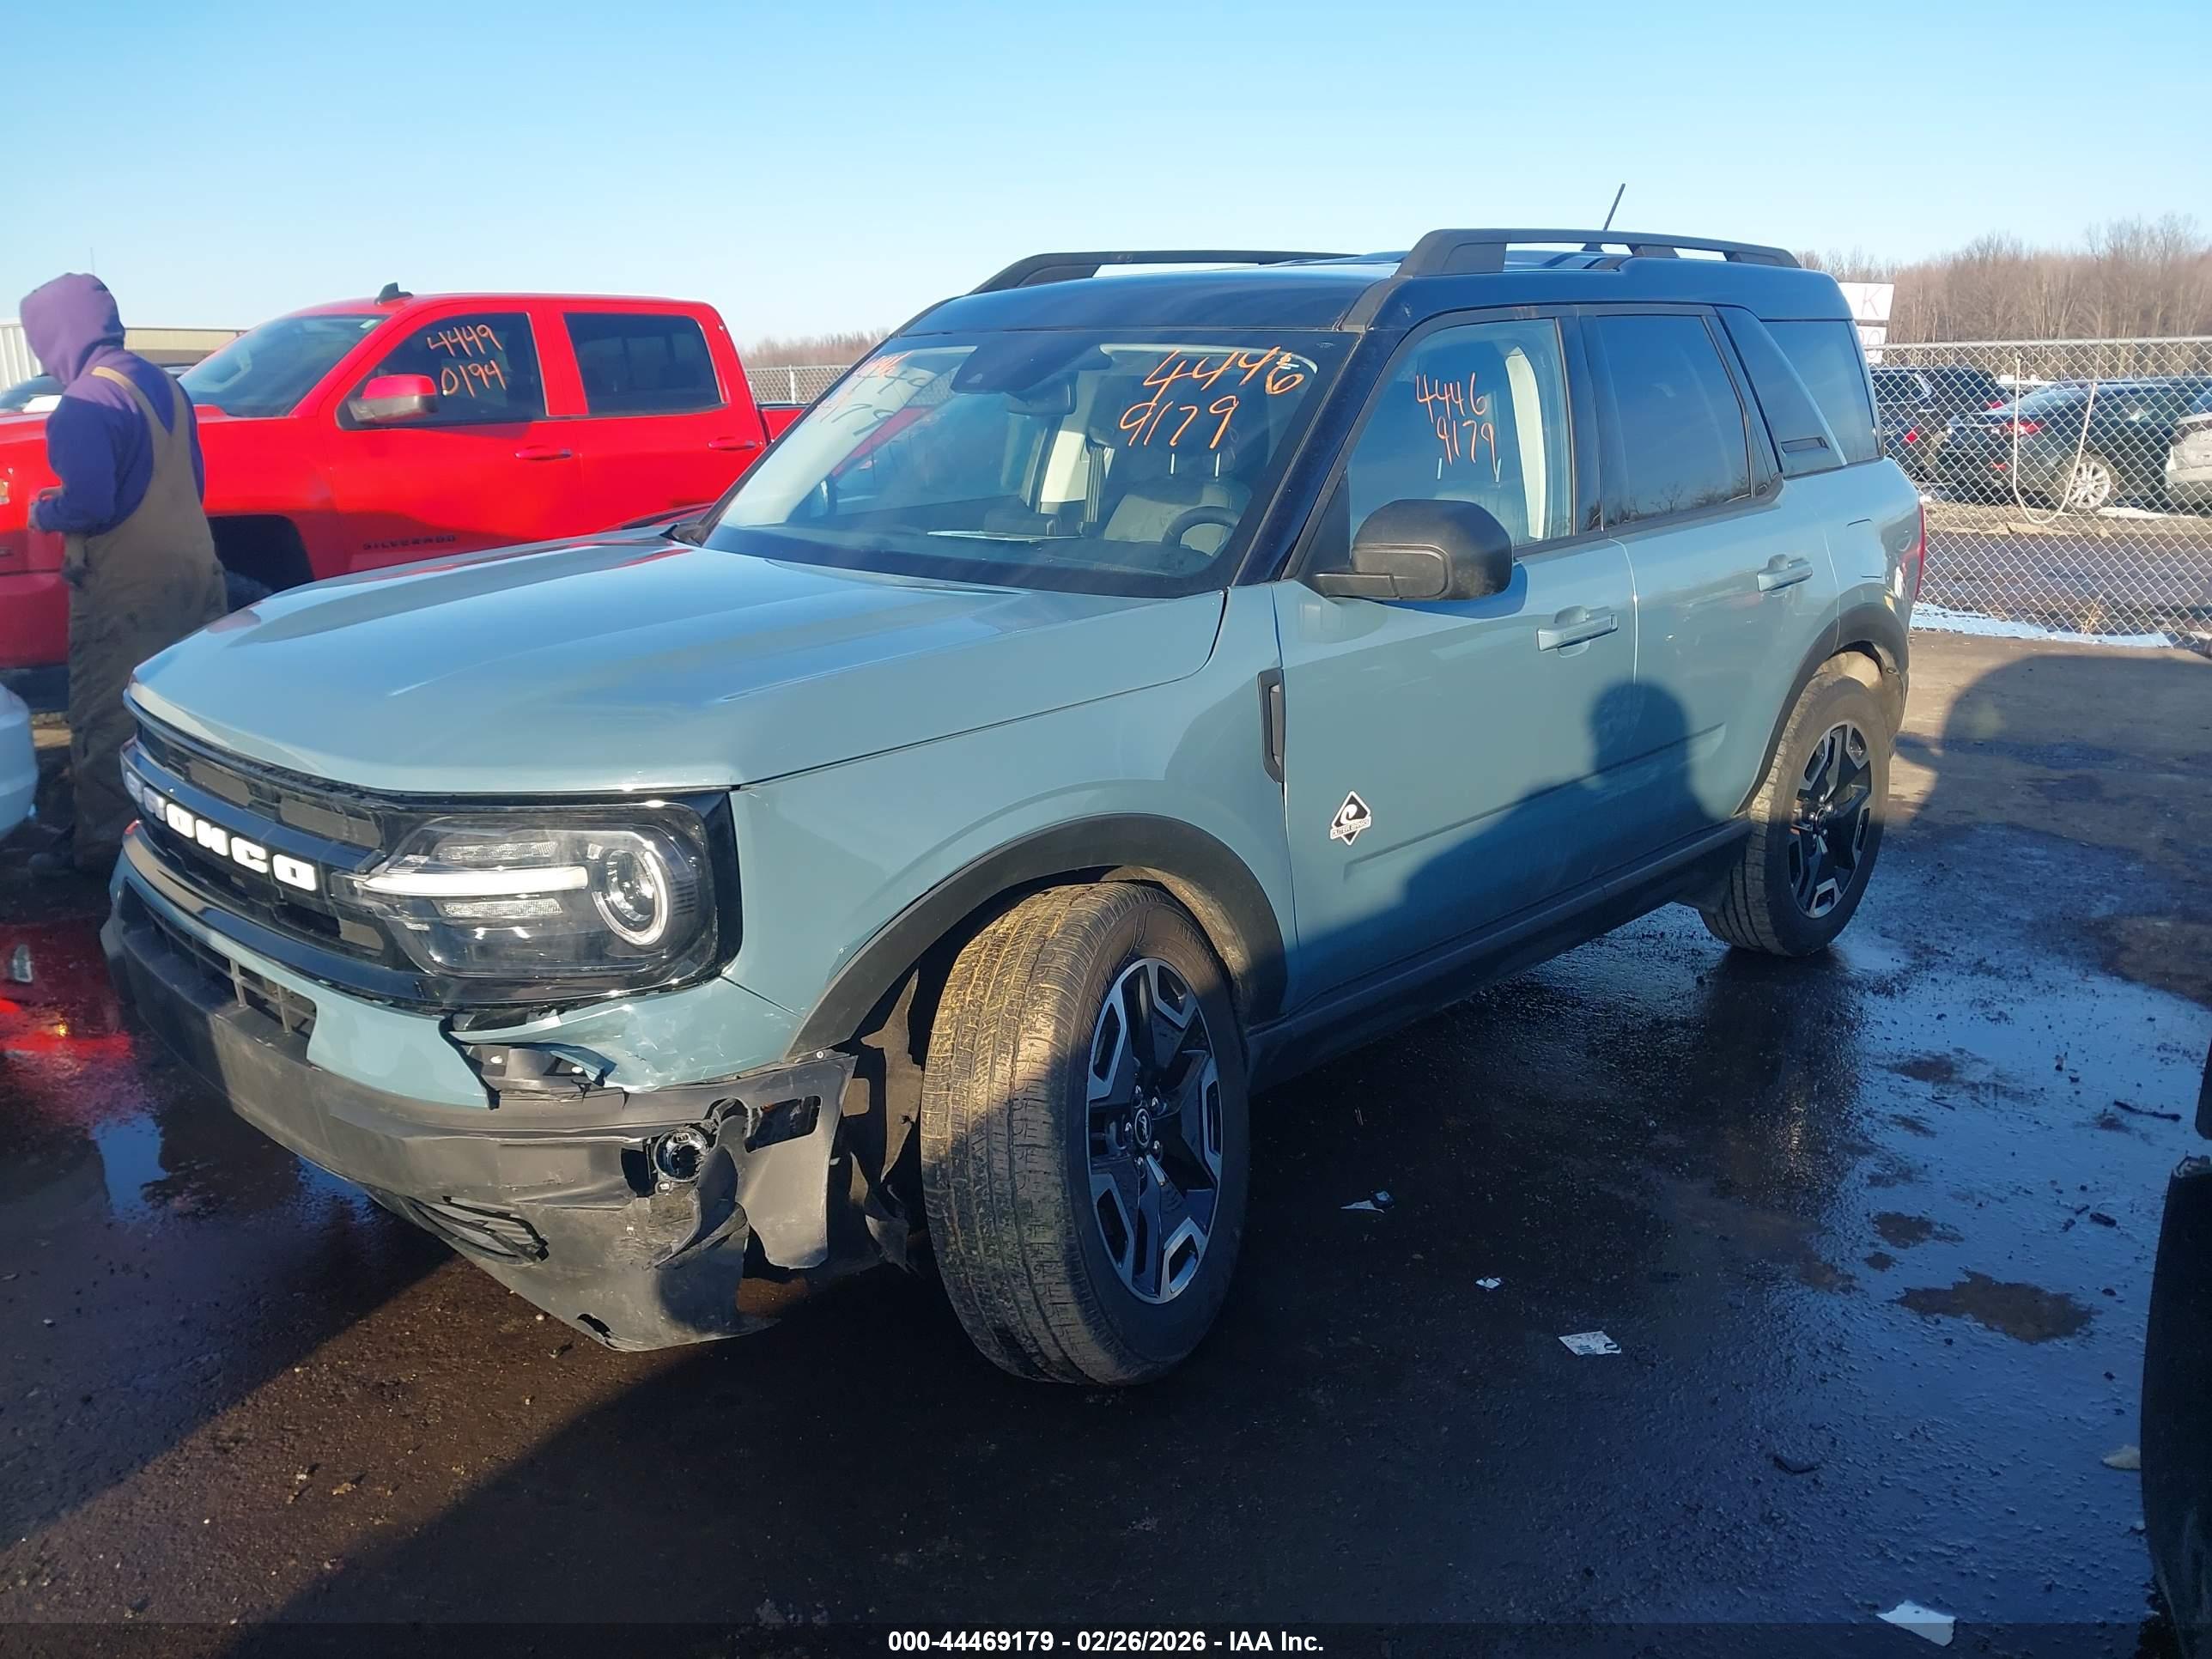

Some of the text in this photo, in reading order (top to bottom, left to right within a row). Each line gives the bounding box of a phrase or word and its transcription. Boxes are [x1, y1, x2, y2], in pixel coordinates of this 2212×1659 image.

[427, 324, 503, 357] 4449
[441, 359, 507, 398] 0194
[1143, 345, 1305, 404] 4446
[1415, 372, 1488, 424] 4446
[1119, 394, 1240, 449] 9179
[1437, 416, 1498, 476] 9179
[127, 771, 317, 891] BRONCO
